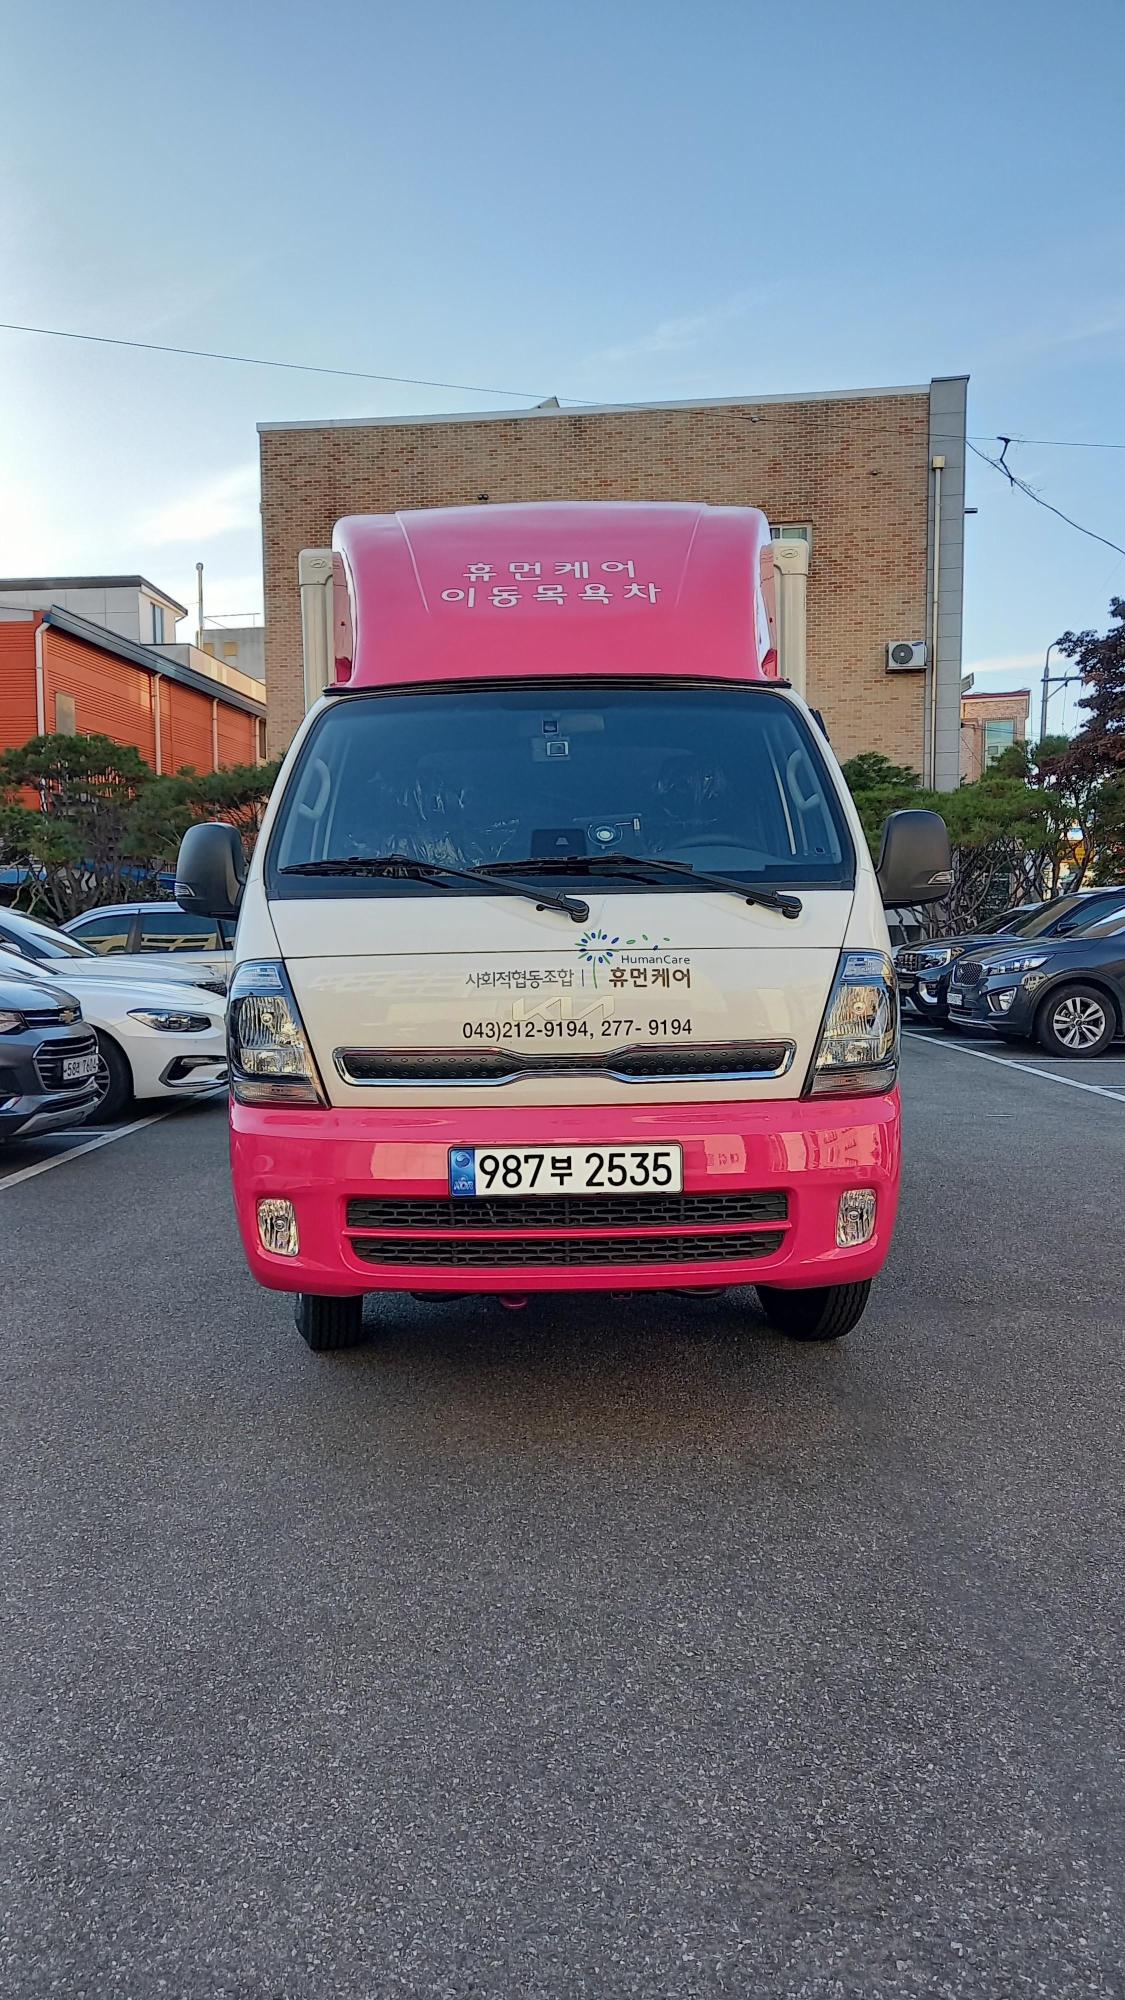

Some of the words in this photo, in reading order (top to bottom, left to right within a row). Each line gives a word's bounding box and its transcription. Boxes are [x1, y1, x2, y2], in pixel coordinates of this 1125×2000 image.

[462, 560, 636, 582] 휴먼케어
[441, 582, 662, 608] 이동목욕차
[621, 954, 691, 965] HumanCare
[465, 968, 575, 989] 사회적협동조합
[608, 966, 692, 989] 휴먼케어
[478, 1154, 573, 1189] 987부
[585, 1151, 673, 1187] 2535
